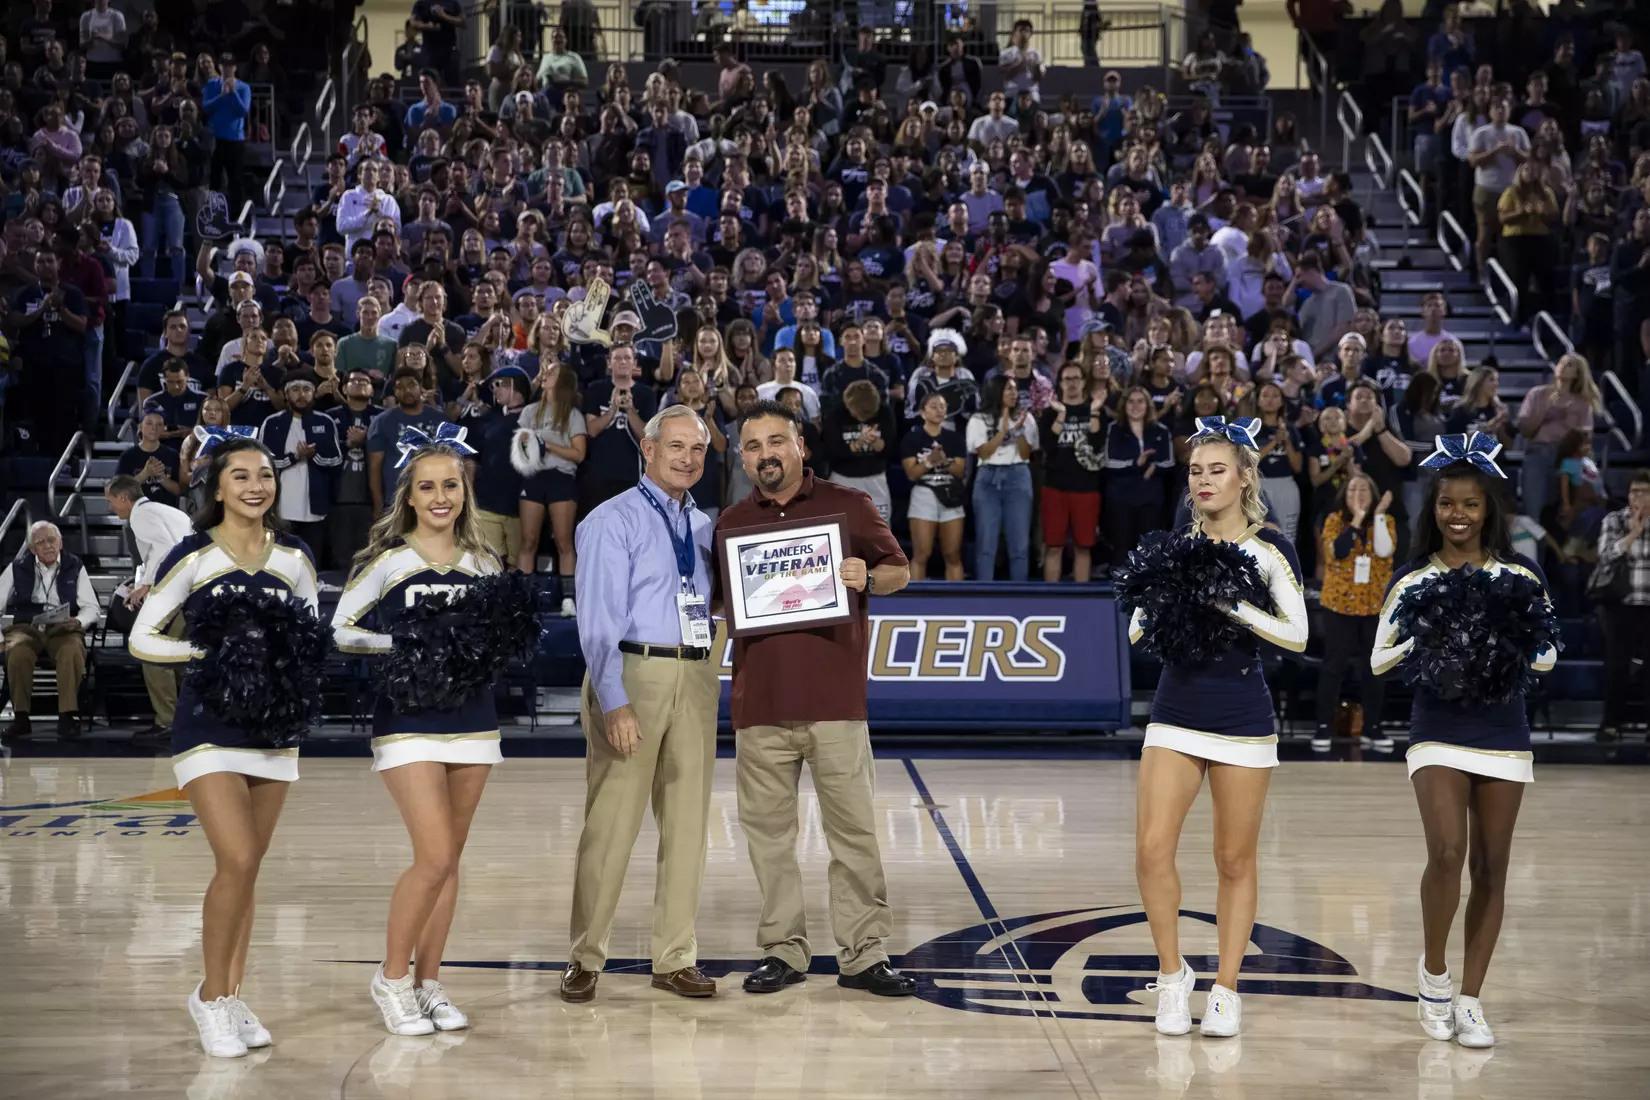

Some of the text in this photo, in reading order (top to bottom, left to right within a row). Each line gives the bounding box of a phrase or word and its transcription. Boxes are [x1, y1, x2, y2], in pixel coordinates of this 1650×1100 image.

[763, 544, 814, 560] LANCERS
[745, 554, 829, 576] VETERAN
[764, 566, 828, 581] OF THE GAME
[710, 615, 1066, 682] LCERS
